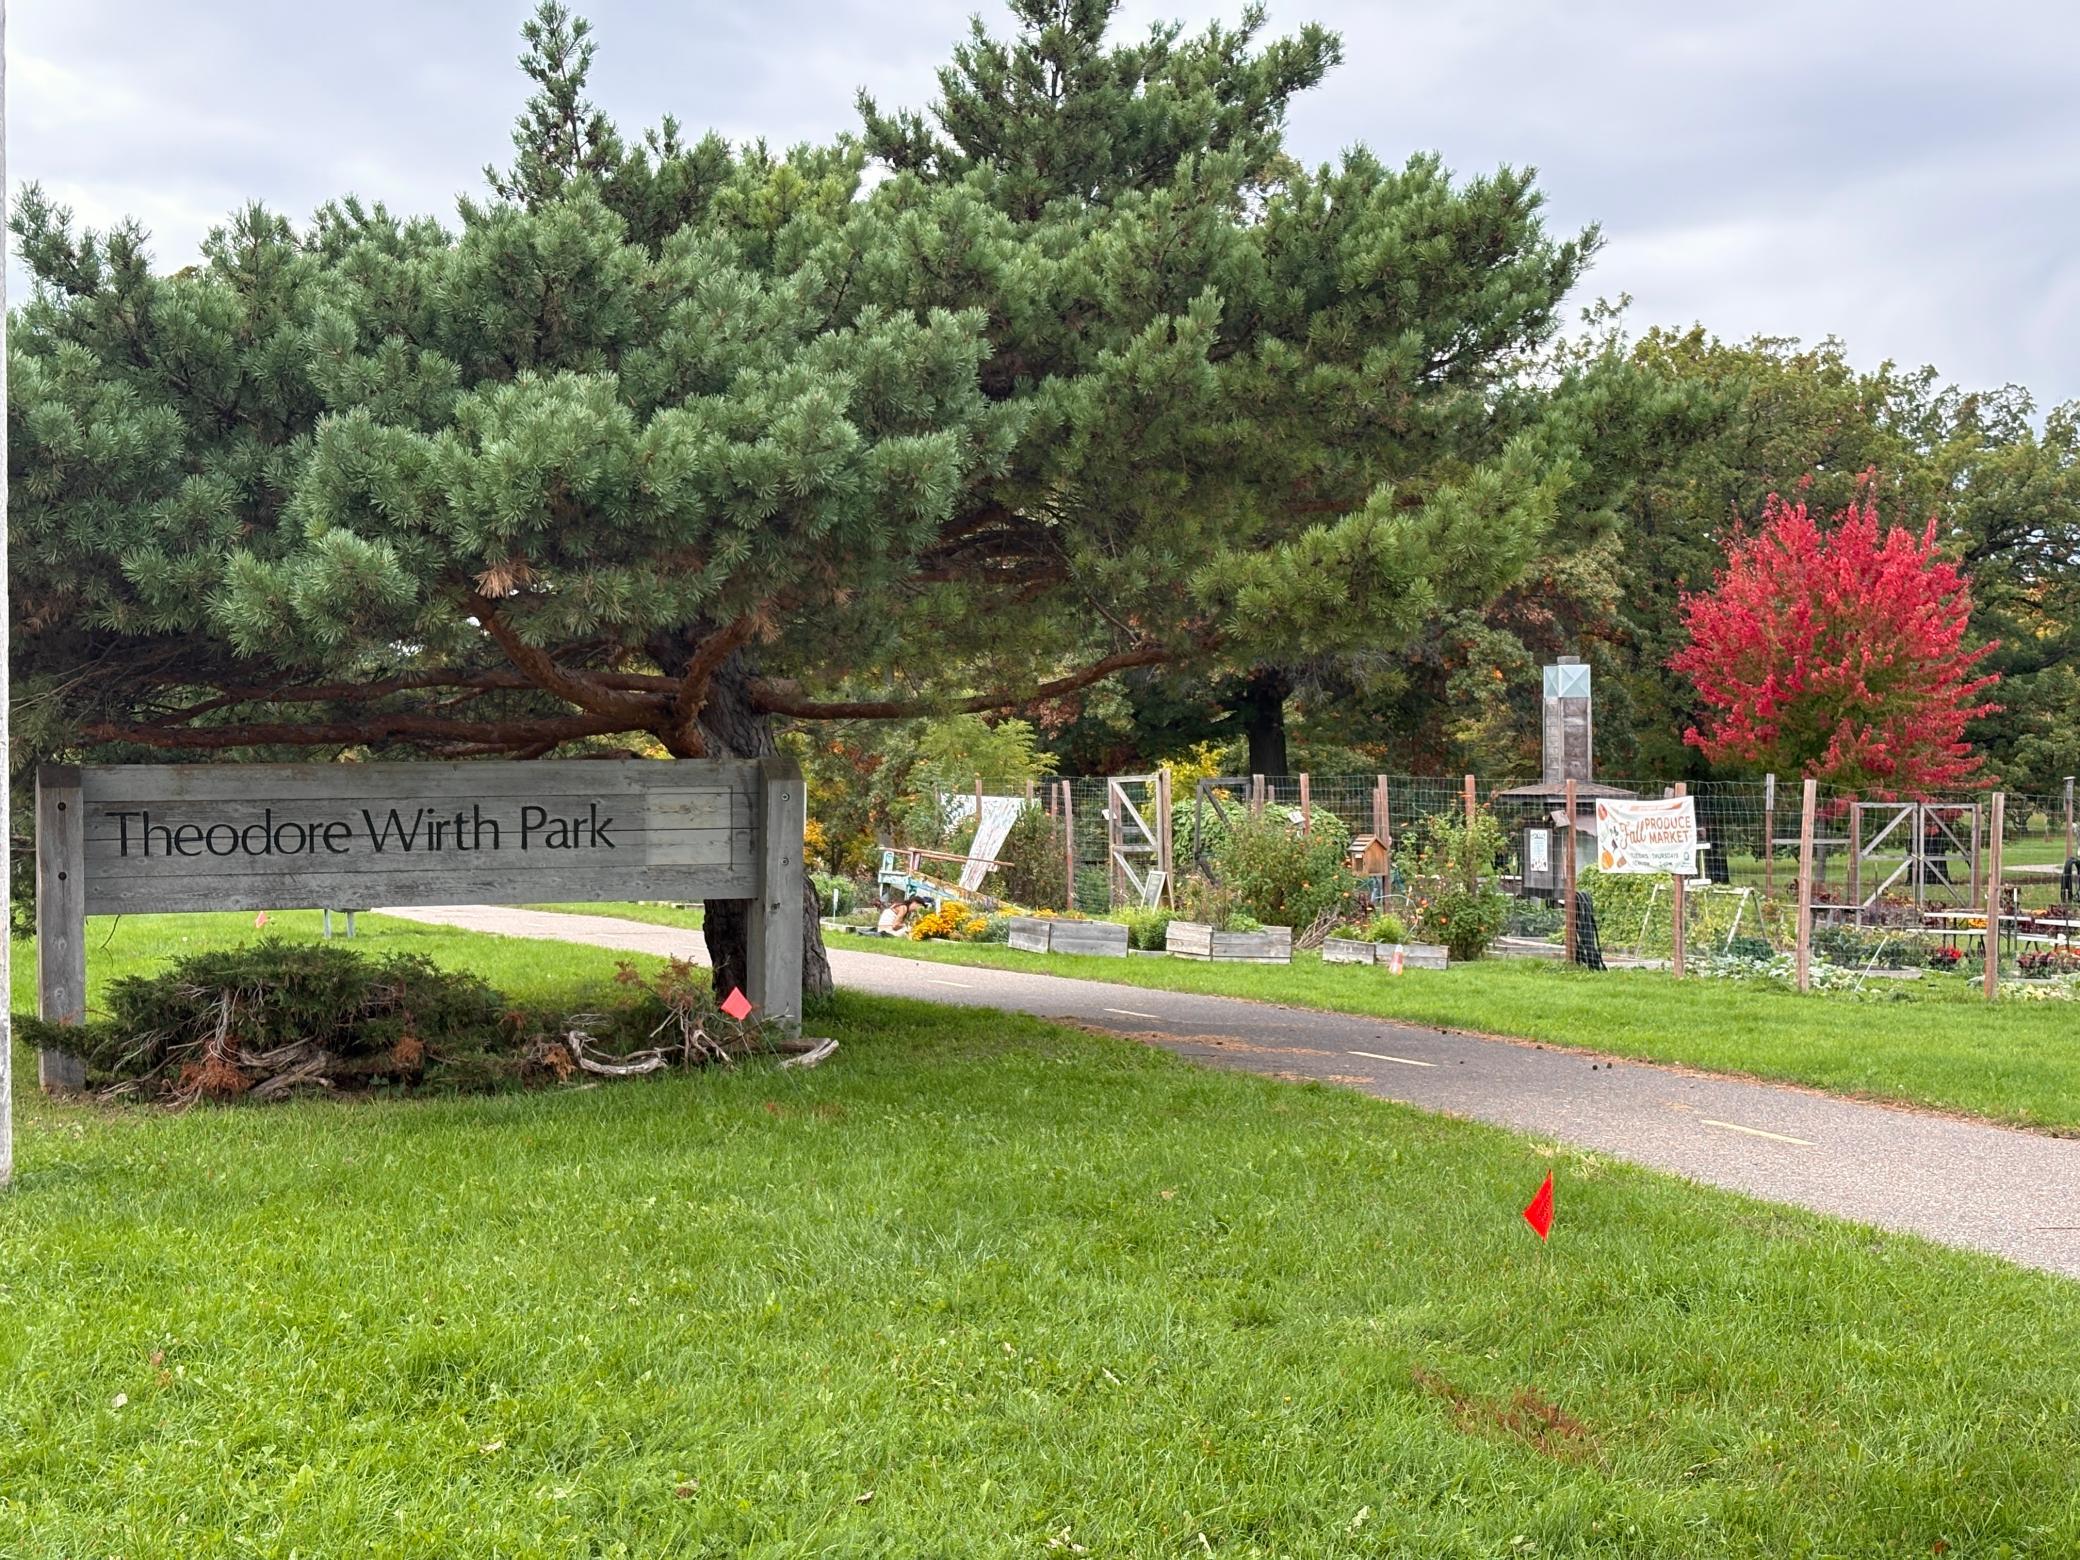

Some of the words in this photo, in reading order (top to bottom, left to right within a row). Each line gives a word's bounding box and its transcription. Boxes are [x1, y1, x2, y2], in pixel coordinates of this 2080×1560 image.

[105, 809, 352, 857] Theodore
[362, 805, 500, 852] Wirth
[521, 803, 615, 850] Park
[1619, 820, 1646, 849] Fall
[1644, 816, 1692, 829] PRODUCE
[1649, 831, 1689, 844] MARKET
